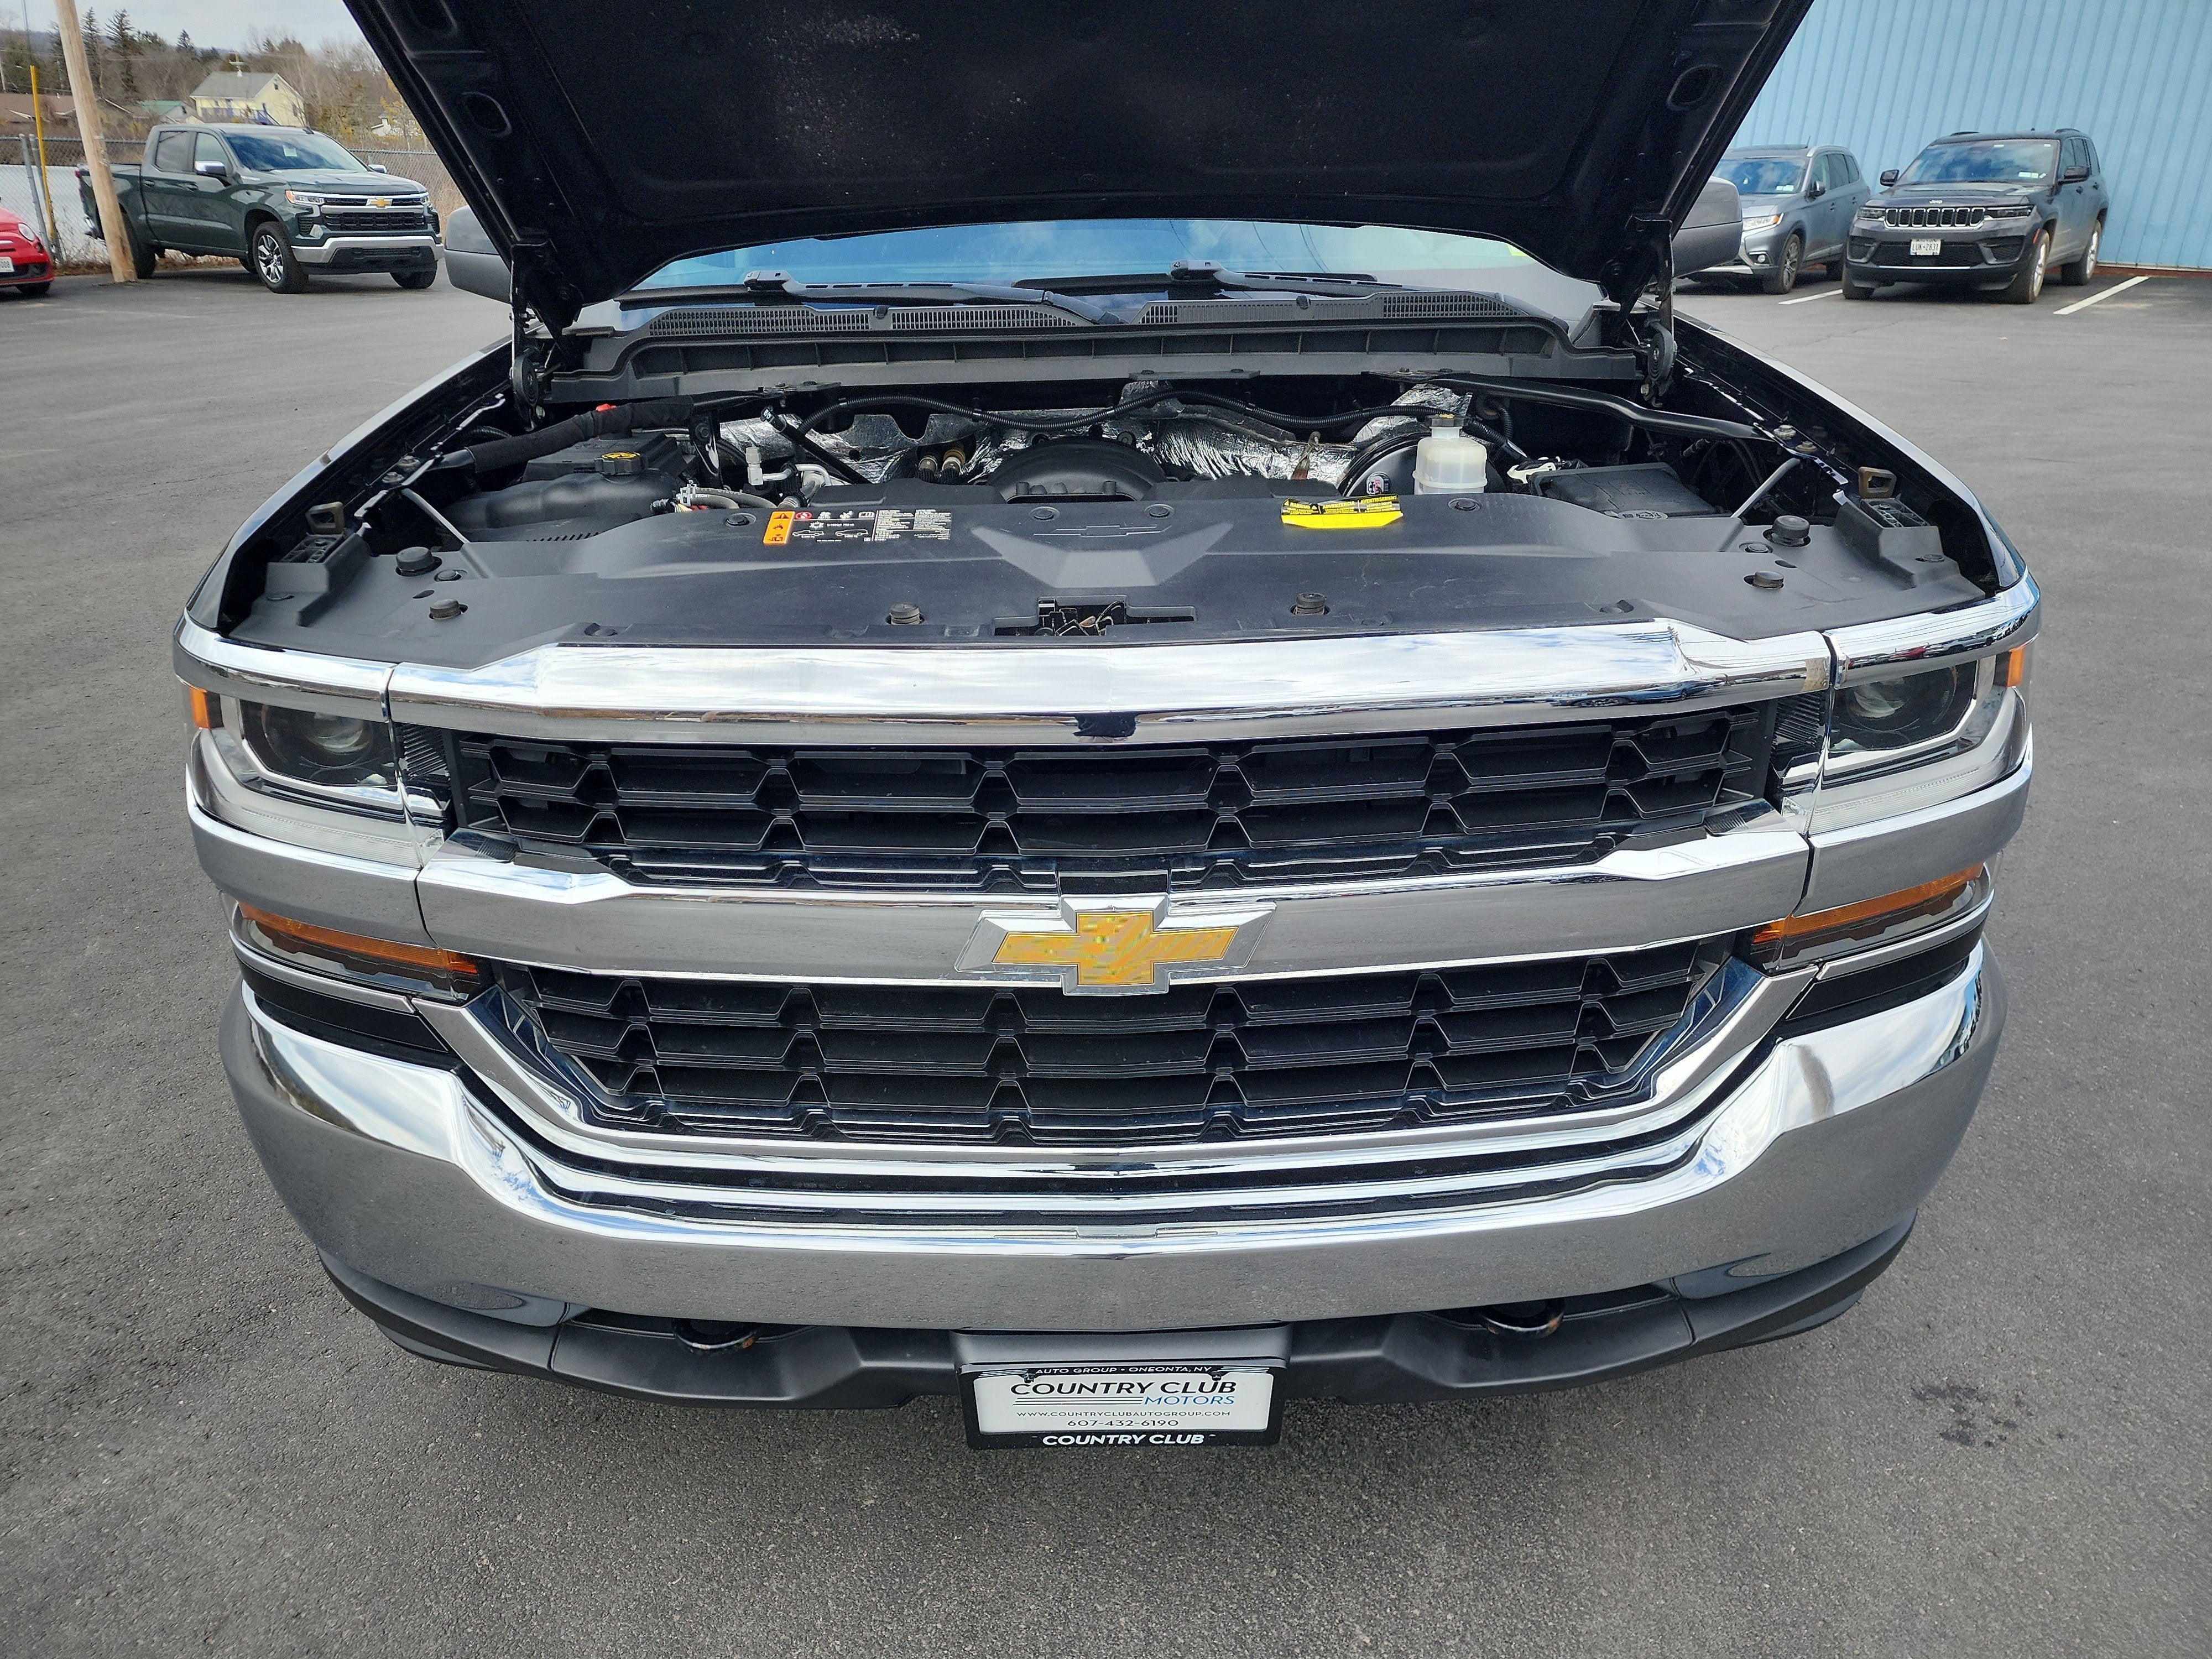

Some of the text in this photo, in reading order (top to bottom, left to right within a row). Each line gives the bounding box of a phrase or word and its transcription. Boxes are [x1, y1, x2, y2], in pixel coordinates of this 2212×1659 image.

[1010, 1381, 1237, 1395] COUNTRY CLUB
[1144, 1395, 1235, 1405] MOTORS
[1042, 1434, 1204, 1446] COUNTRY CLUB
